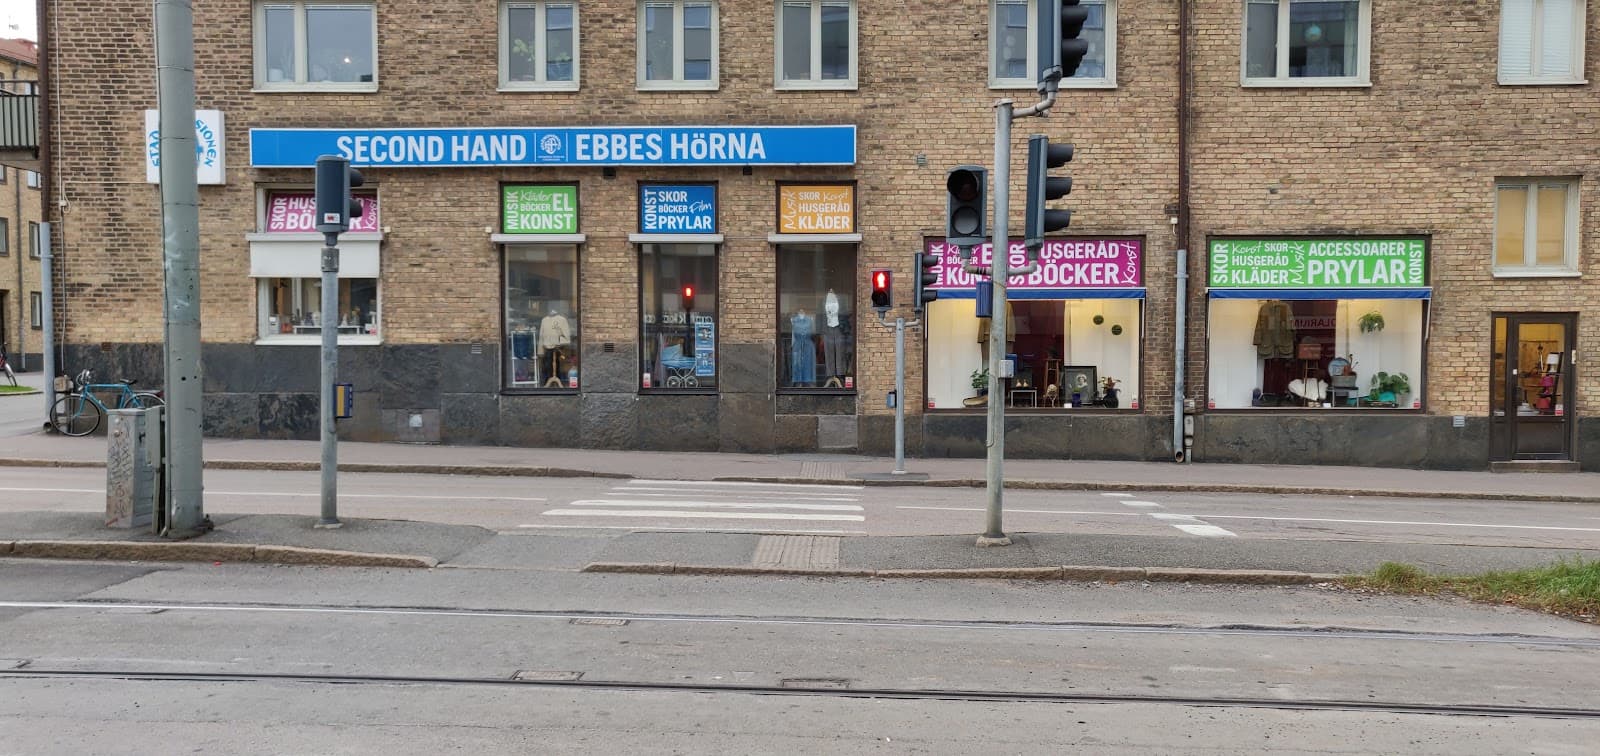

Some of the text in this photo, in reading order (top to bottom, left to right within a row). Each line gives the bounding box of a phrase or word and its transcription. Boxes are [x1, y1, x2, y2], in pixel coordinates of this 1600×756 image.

[336, 135, 445, 163] SECOND
[452, 134, 527, 162] HAND
[576, 133, 662, 161] EBBES
[552, 193, 574, 212] EL
[658, 191, 688, 203] SKOR
[799, 191, 820, 201] SKOR
[271, 197, 288, 230] SKOR
[507, 191, 519, 230] MUSIK
[520, 202, 551, 212] BÖCKER
[644, 189, 657, 230] KONST
[658, 203, 688, 214] BÖCKER
[798, 200, 850, 213] HUSGERÅD
[520, 213, 574, 230] KONST
[658, 215, 712, 230] PRYLAR
[798, 213, 850, 230] KLÄDER
[1232, 241, 1288, 255] Konst SKOR
[1308, 242, 1406, 257] ACCESSOARER
[1120, 241, 1137, 285] Konst
[1213, 243, 1229, 284] SKOR
[1231, 252, 1289, 267] HUSGERÅD
[1288, 241, 1305, 285] Musik
[1409, 242, 1423, 283] KONST
[1028, 259, 1119, 285] BÖCKER
[1231, 266, 1289, 285] KLÄDER
[1307, 259, 1407, 284] PRYLAR
